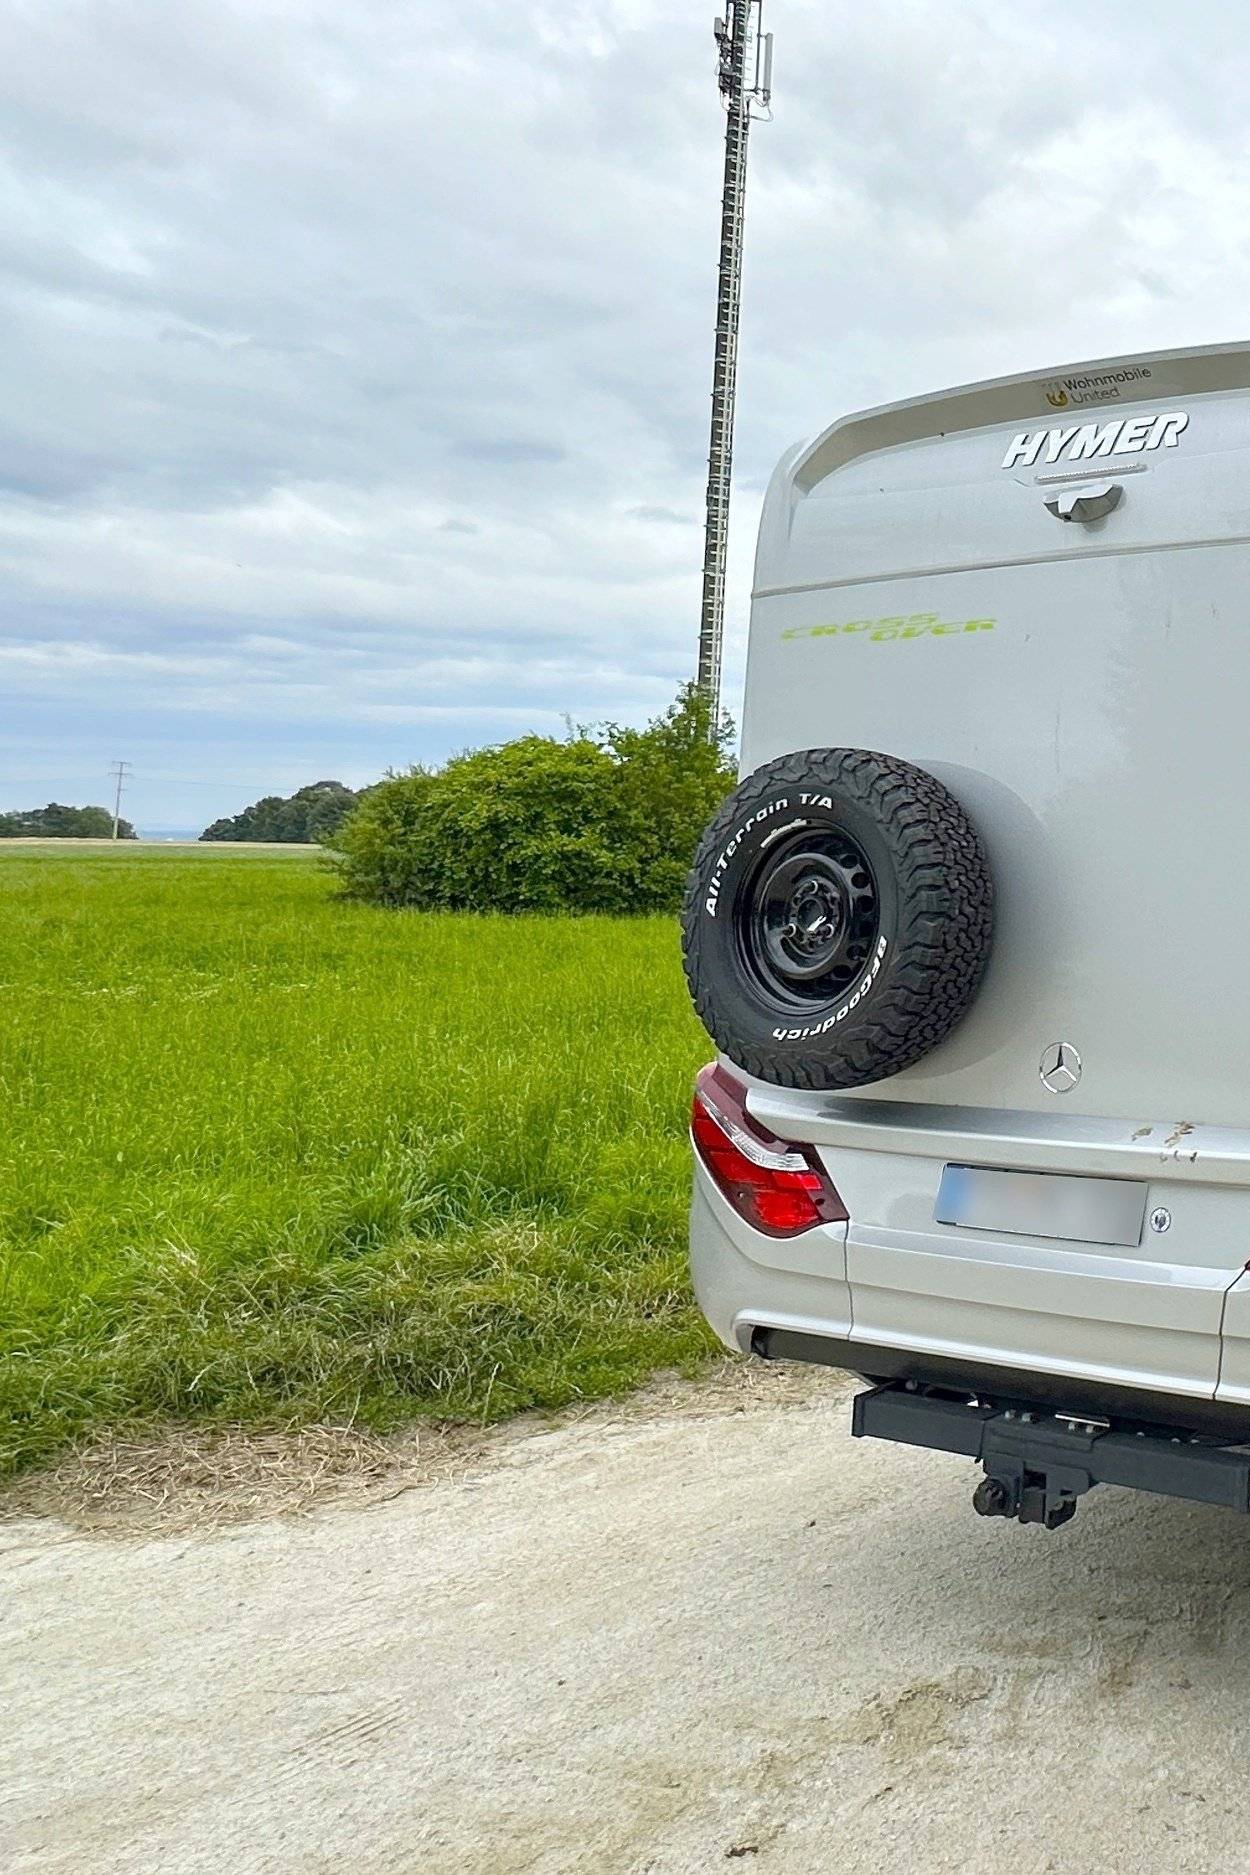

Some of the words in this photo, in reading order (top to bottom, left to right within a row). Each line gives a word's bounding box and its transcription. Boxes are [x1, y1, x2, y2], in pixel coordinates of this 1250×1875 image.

[1064, 367, 1152, 391] Wohnmobile
[1070, 386, 1121, 404] United
[1001, 411, 1189, 469] HYMER
[705, 797, 788, 918] All-Terrain
[799, 792, 834, 810] T/A
[772, 935, 888, 1042] BFGoodrich
